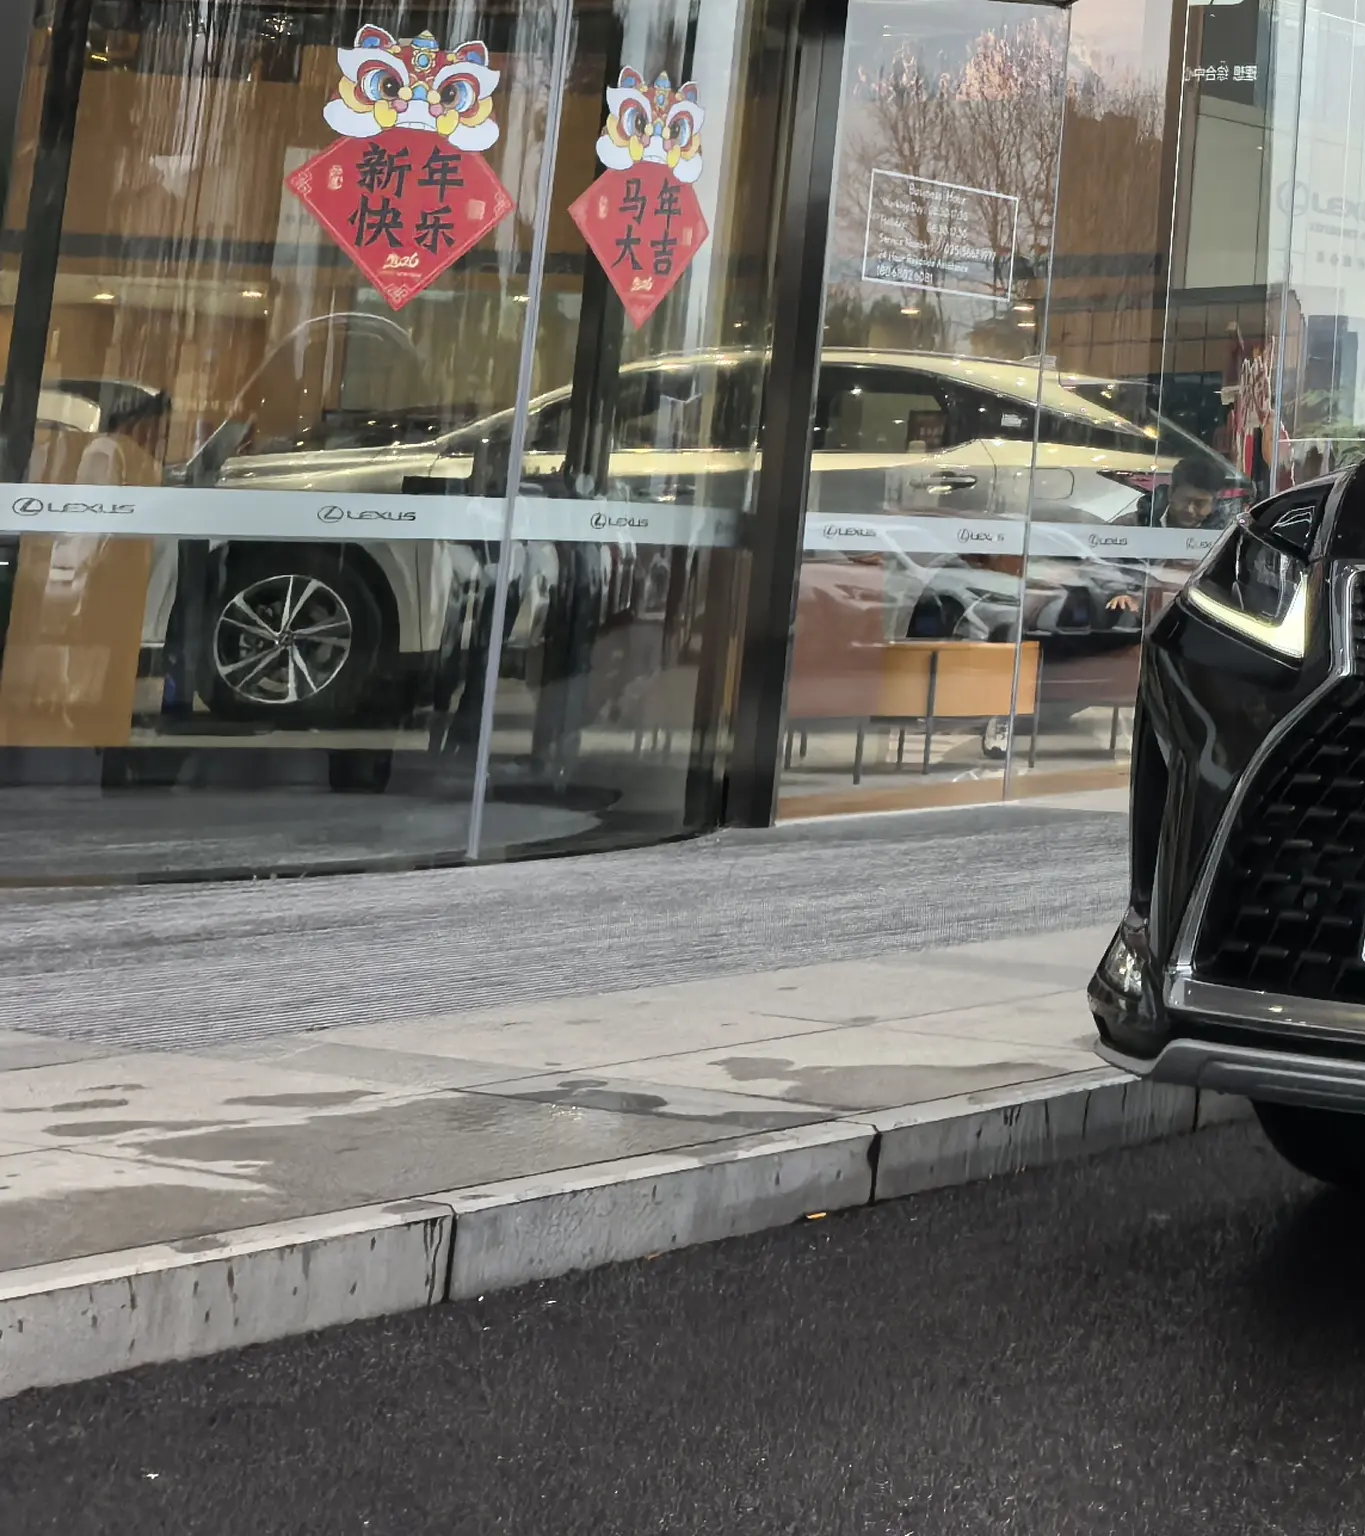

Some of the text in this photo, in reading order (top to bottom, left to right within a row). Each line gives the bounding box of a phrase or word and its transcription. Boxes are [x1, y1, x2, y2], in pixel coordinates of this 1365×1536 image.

[356, 142, 464, 203] 新年
[618, 177, 682, 231] 马年
[348, 195, 456, 254] 快乐
[611, 224, 677, 276] 大吉
[47, 502, 136, 514] LEXUS
[346, 510, 416, 522] LEXUS
[608, 517, 649, 528] LEXUS
[969, 531, 1005, 542] LEXS
